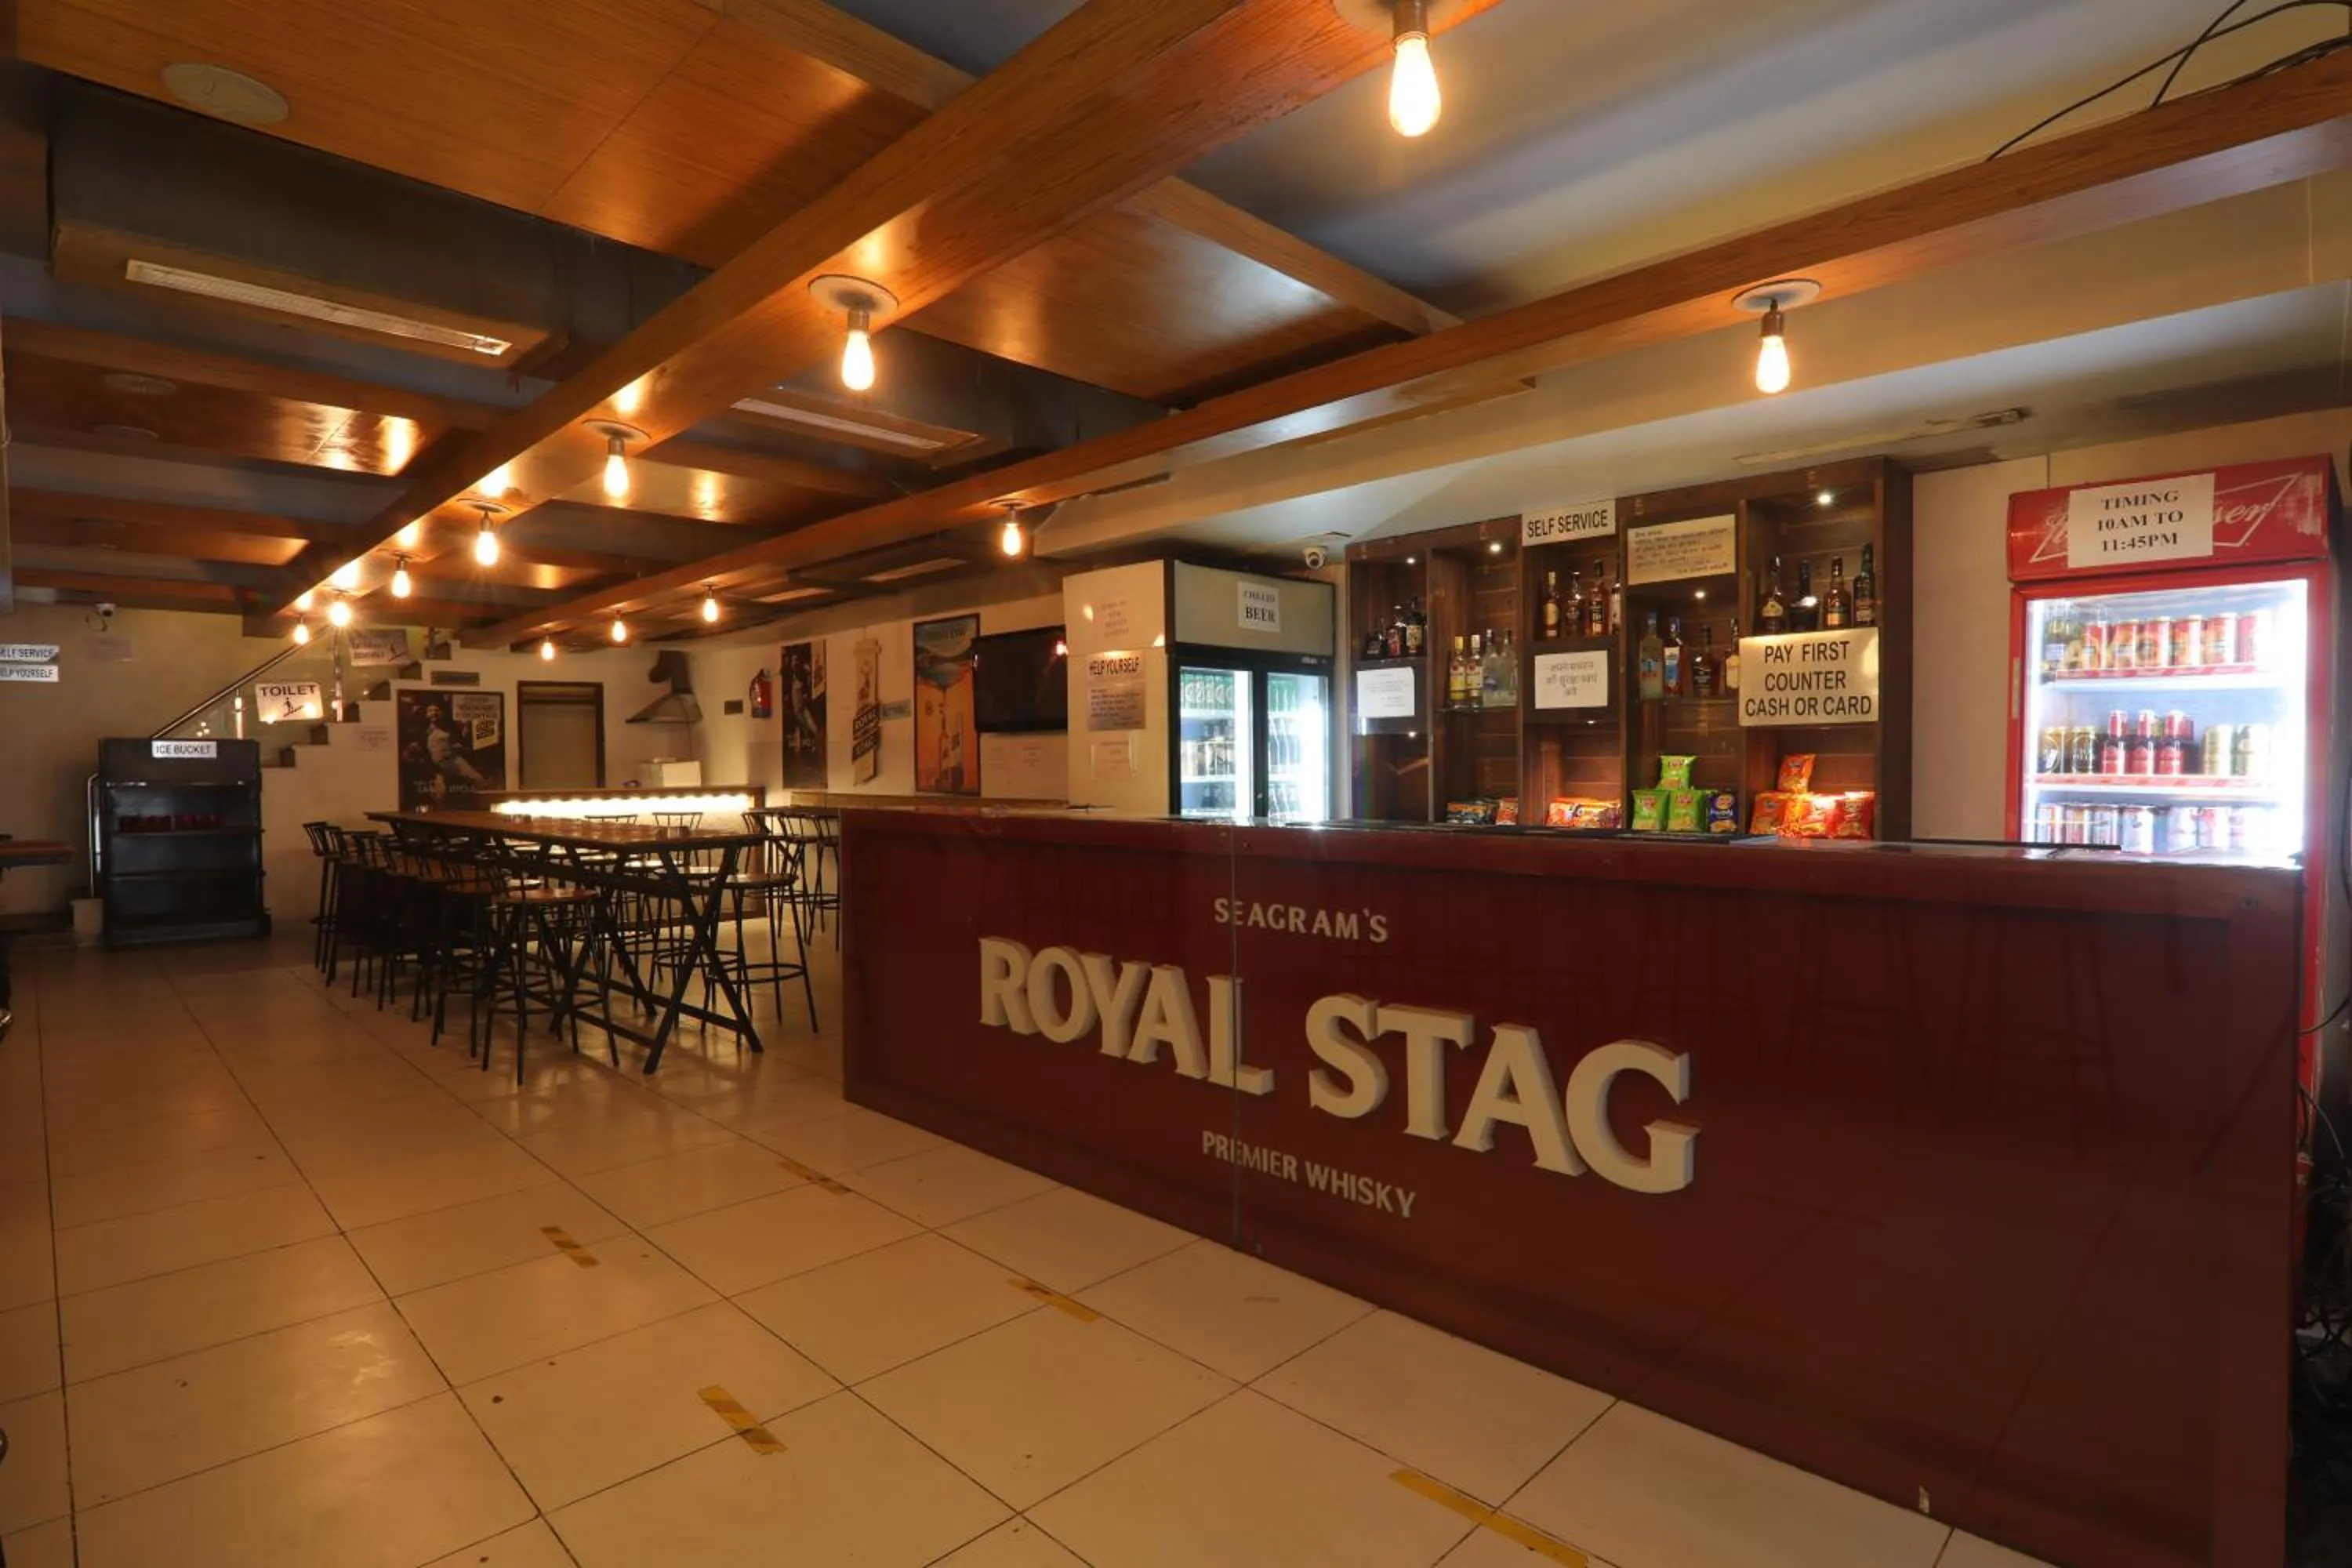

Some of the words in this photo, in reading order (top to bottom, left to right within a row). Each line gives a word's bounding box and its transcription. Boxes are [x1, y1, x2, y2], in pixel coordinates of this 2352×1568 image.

[2101, 490, 2179, 510] TIMING
[1528, 518, 1555, 538] SELF
[1558, 509, 1608, 533] SERVICE
[2097, 514, 2148, 532] 10AM
[2154, 510, 2183, 525] TO
[2102, 532, 2178, 552] 11:45PM
[1246, 606, 1276, 622] BEER
[1765, 644, 1793, 663] PAY
[1802, 641, 1850, 662] FIRST
[16, 669, 53, 678] YOURSELF
[1089, 660, 1104, 675] HELP
[260, 684, 317, 697] TOILET
[1765, 670, 1846, 691] COUNTER
[1745, 697, 1789, 717] CASH
[1795, 697, 1818, 716] OR
[1823, 696, 1871, 715] CARD
[155, 745, 172, 755] ICE
[174, 745, 210, 755] BUCKET
[1214, 898, 1388, 943] SEAGRAM'S
[978, 935, 1274, 1095] ROYAL
[1305, 992, 1701, 1194] STAG
[1202, 1130, 1298, 1183] PREMIER
[1305, 1160, 1416, 1218] WHISKY
